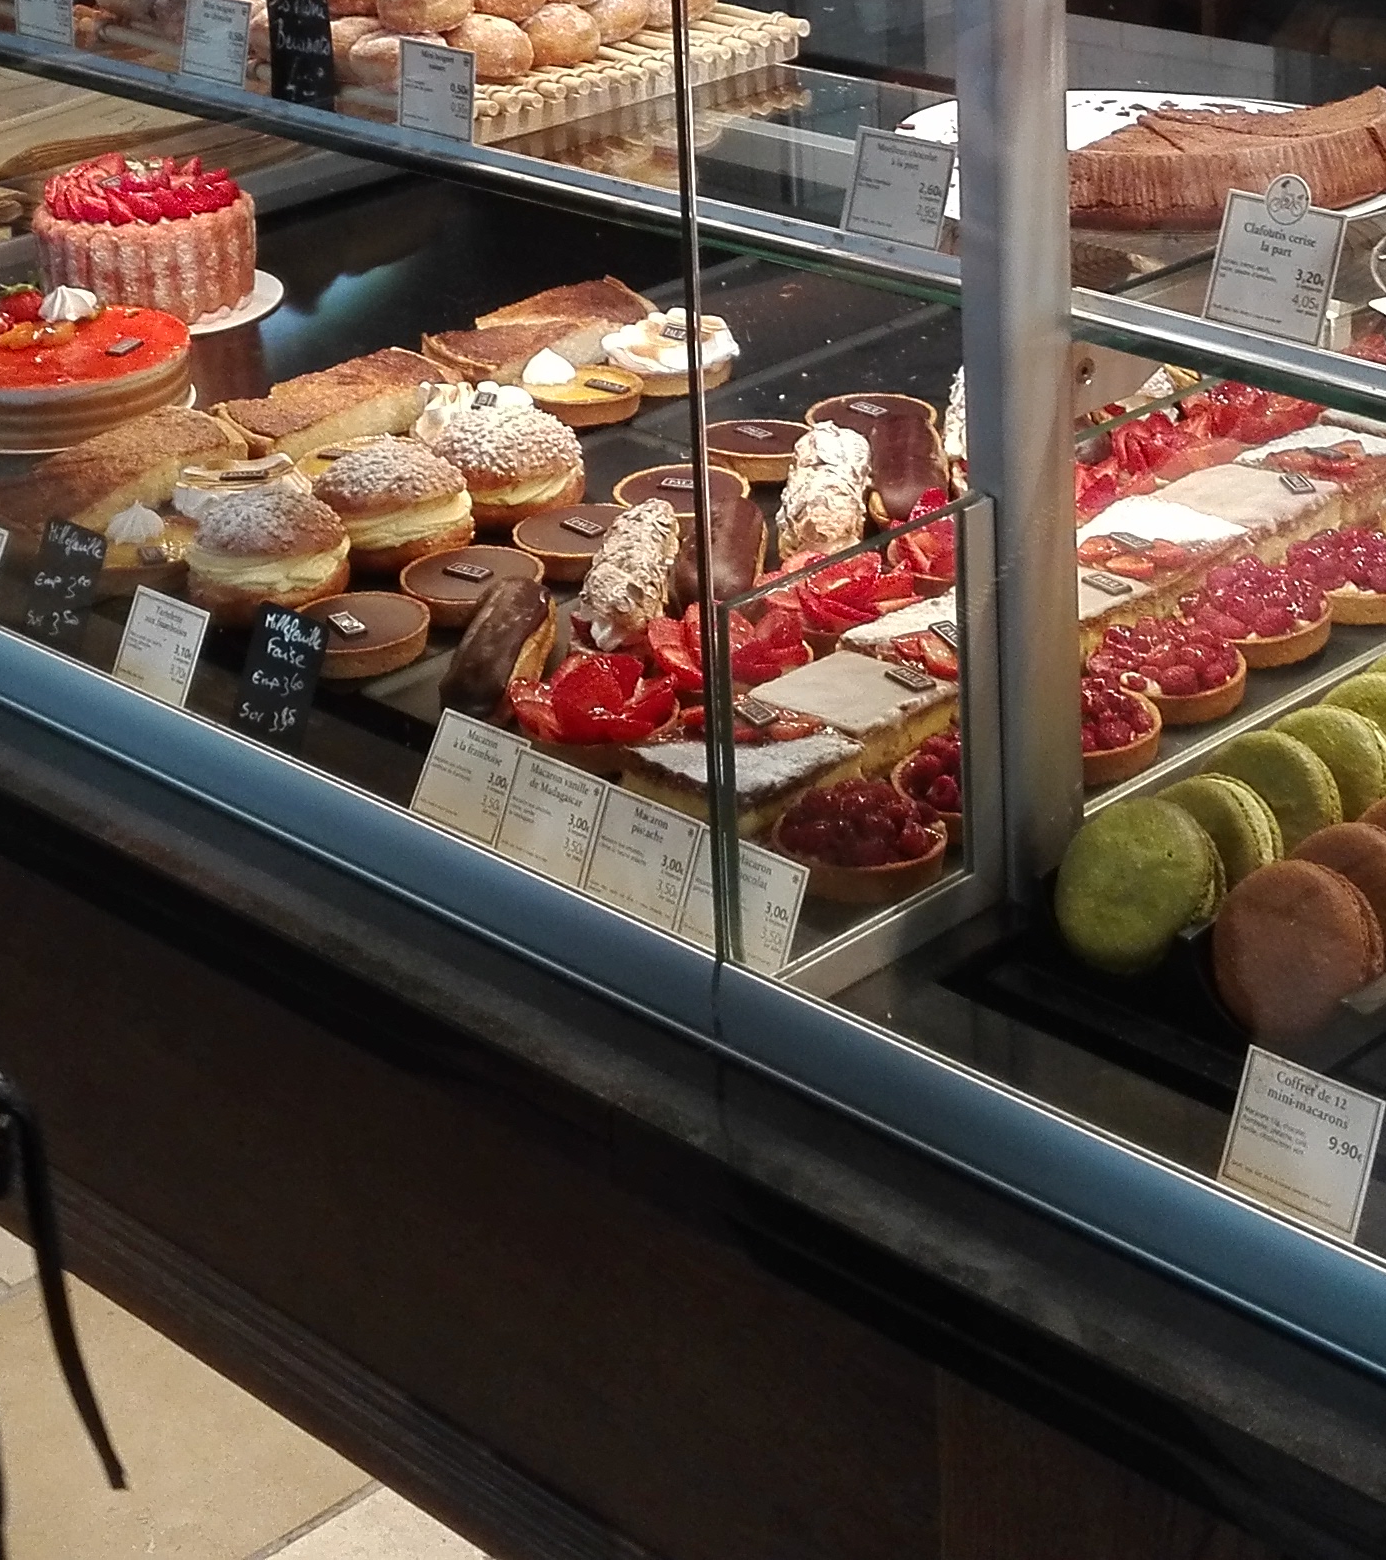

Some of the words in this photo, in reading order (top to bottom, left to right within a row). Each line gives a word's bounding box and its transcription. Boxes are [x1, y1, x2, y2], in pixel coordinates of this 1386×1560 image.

[1243, 221, 1287, 241] Clafoutis
[1288, 233, 1317, 248] cerise
[1260, 240, 1269, 252] la
[1270, 244, 1293, 258] part
[1295, 268, 1326, 287] 3,20€
[467, 728, 499, 750] Macaron
[467, 742, 503, 768] framboise
[530, 762, 563, 785] Macaron
[563, 775, 590, 796] vanille
[529, 778, 540, 790] de
[540, 782, 584, 809] Madagascar
[633, 806, 670, 831] Macaron
[630, 823, 664, 844] pistache
[1276, 1070, 1316, 1094] Coffret
[1317, 1089, 1331, 1103] de
[1333, 1095, 1348, 1111] 12
[1267, 1087, 1349, 1131] mini-macarons
[1327, 1135, 1366, 1163] 9,90€
